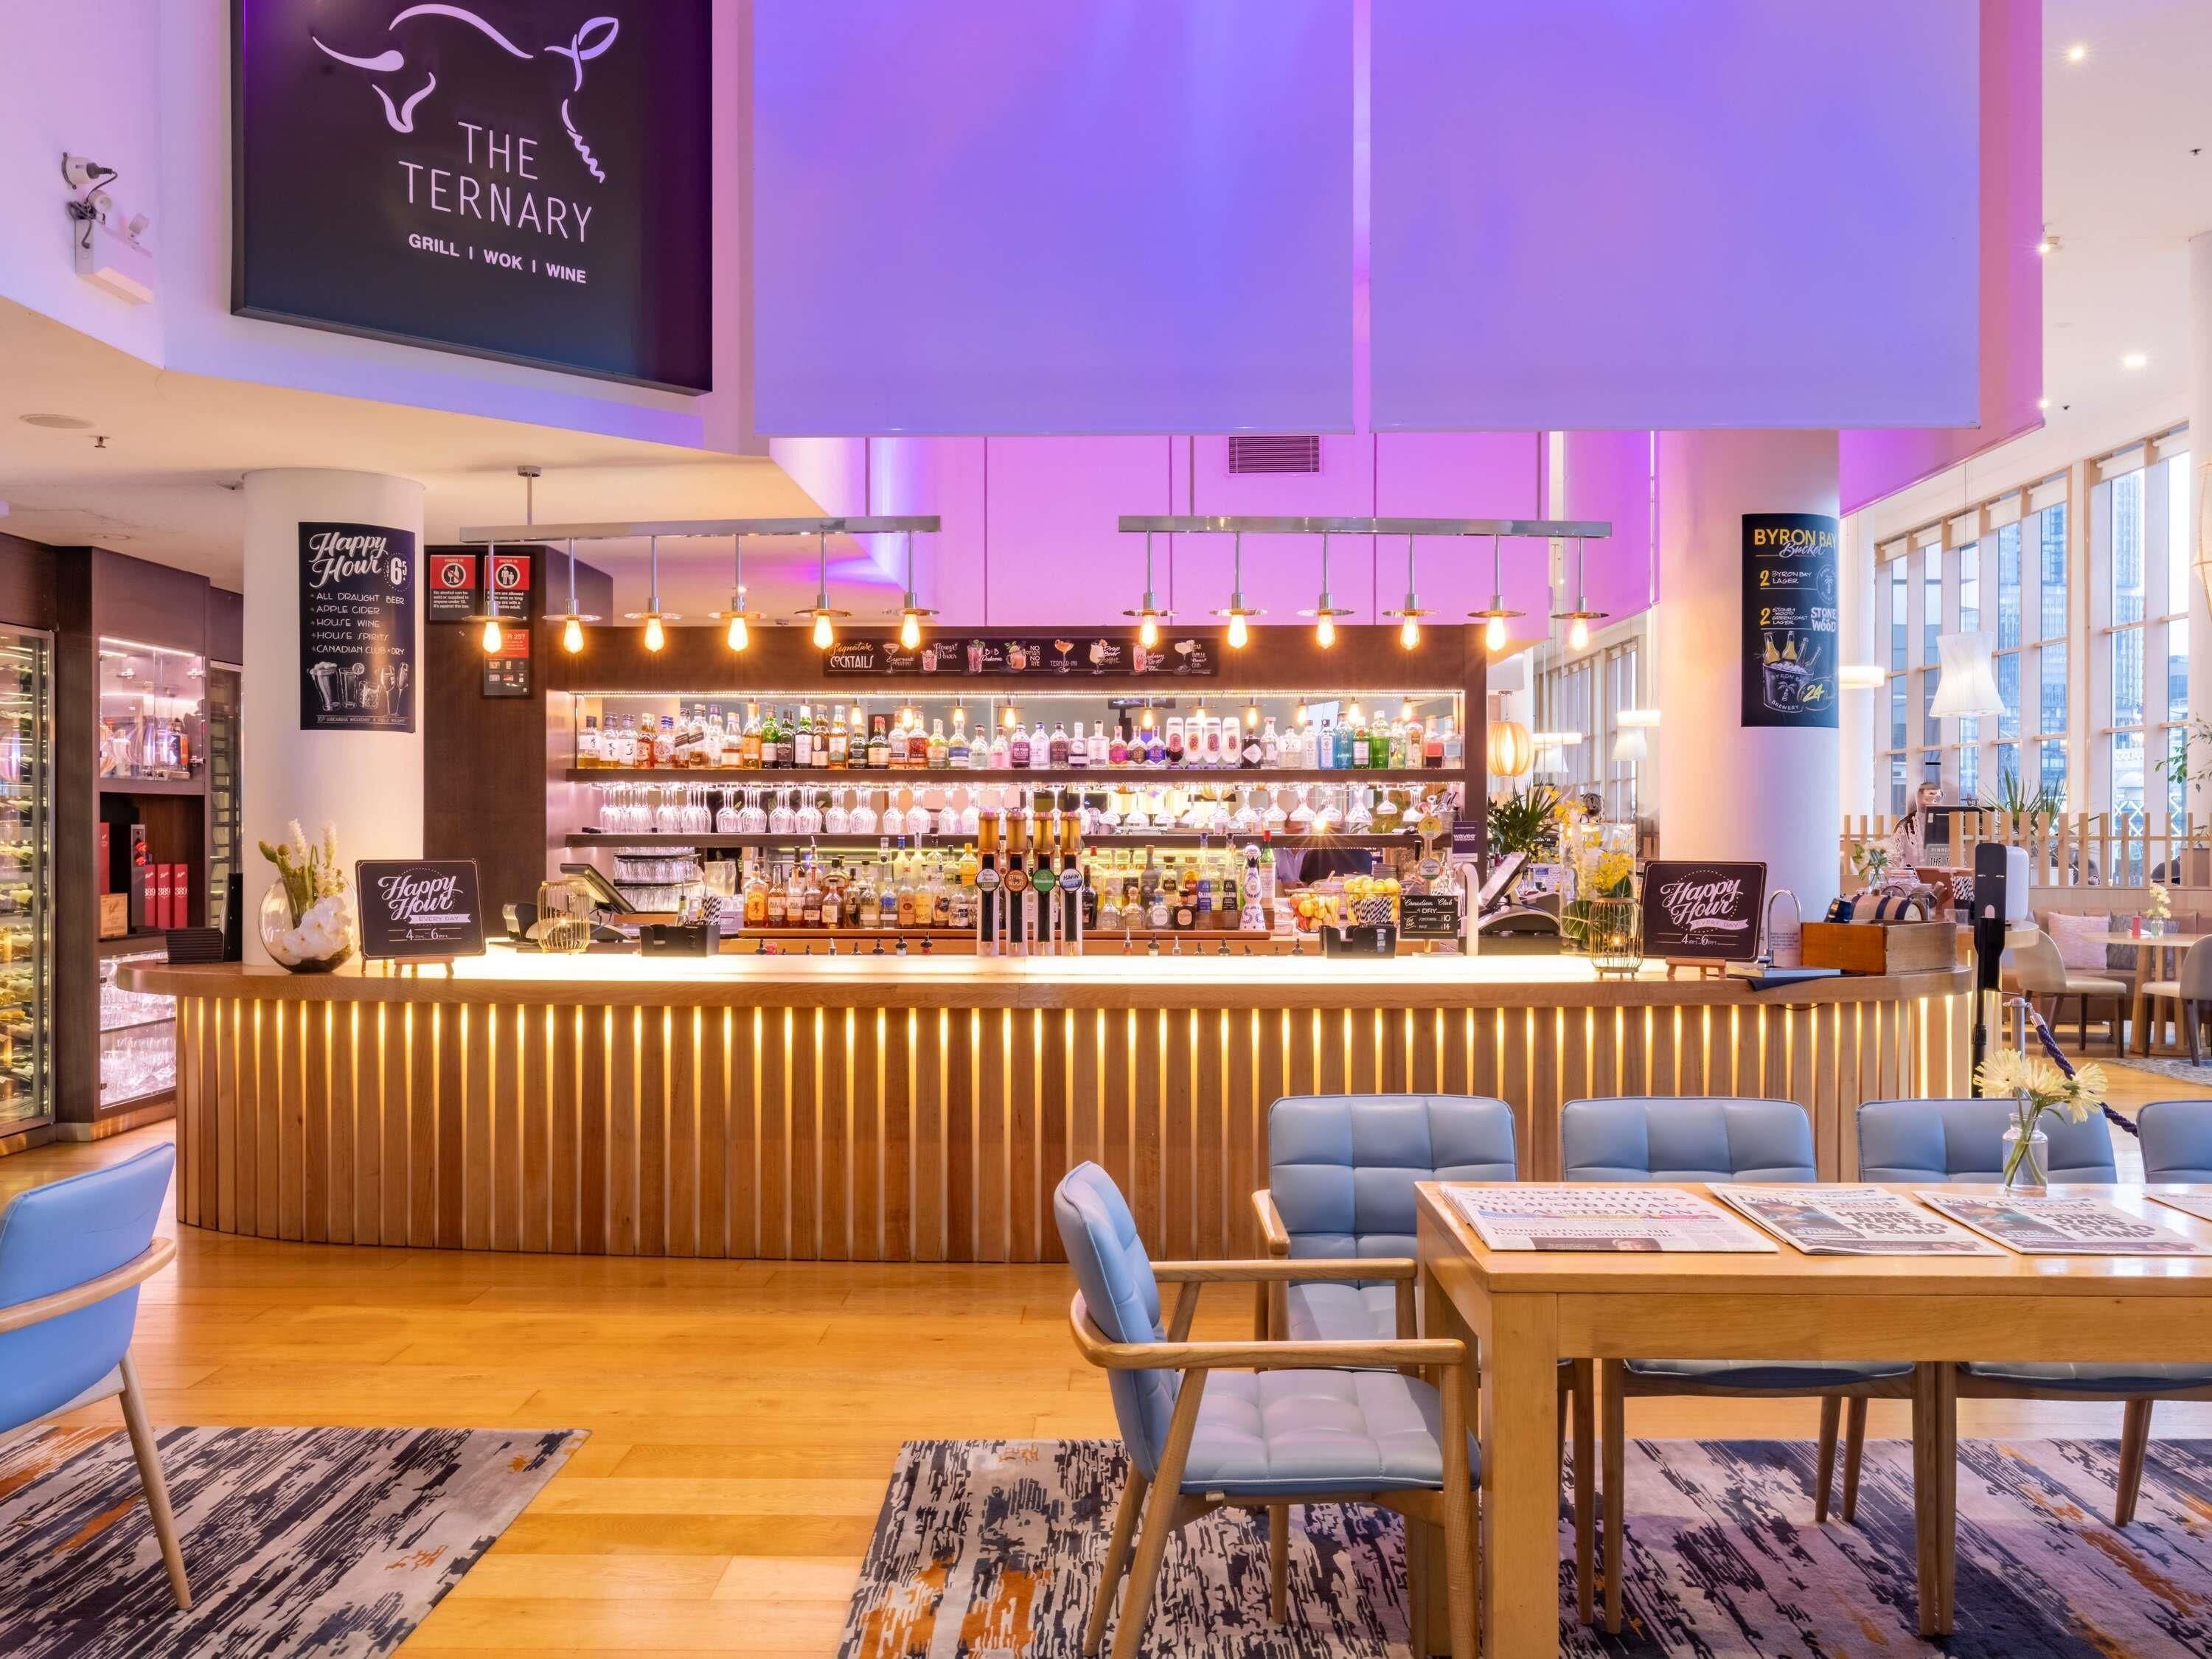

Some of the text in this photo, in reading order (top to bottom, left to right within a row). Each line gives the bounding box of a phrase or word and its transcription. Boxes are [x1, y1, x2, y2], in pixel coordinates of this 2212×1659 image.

[458, 121, 538, 180] THE
[398, 160, 592, 243] TERNARY
[408, 233, 460, 257] GRILL
[484, 248, 523, 271] WOK
[546, 262, 587, 283] WINE
[1755, 529, 1816, 546] BYRON
[308, 532, 389, 562] Happy
[1778, 540, 1825, 557] Bucket
[309, 554, 383, 588] Hour
[1760, 570, 1770, 587] 2
[338, 593, 380, 602] DRAUGHT
[386, 596, 405, 605] BEER
[316, 605, 380, 614] APPLE CIDER
[1760, 608, 1770, 625] 2
[1811, 608, 1837, 619] STONE
[357, 619, 380, 627] WINE
[1812, 619, 1836, 632] WOOD
[358, 633, 389, 641] SPIRITS
[316, 645, 363, 653] CANADIAN
[365, 647, 386, 655] CLUB
[830, 643, 873, 655] Signature
[830, 655, 874, 668] COCKTAILS
[158, 887, 170, 897] 389
[175, 886, 187, 897] 389
[378, 874, 464, 901] Happy
[1660, 879, 1744, 908] Happy
[389, 893, 453, 921] Hour
[1404, 899, 1433, 907] Canadian
[1669, 898, 1733, 925] Hour
